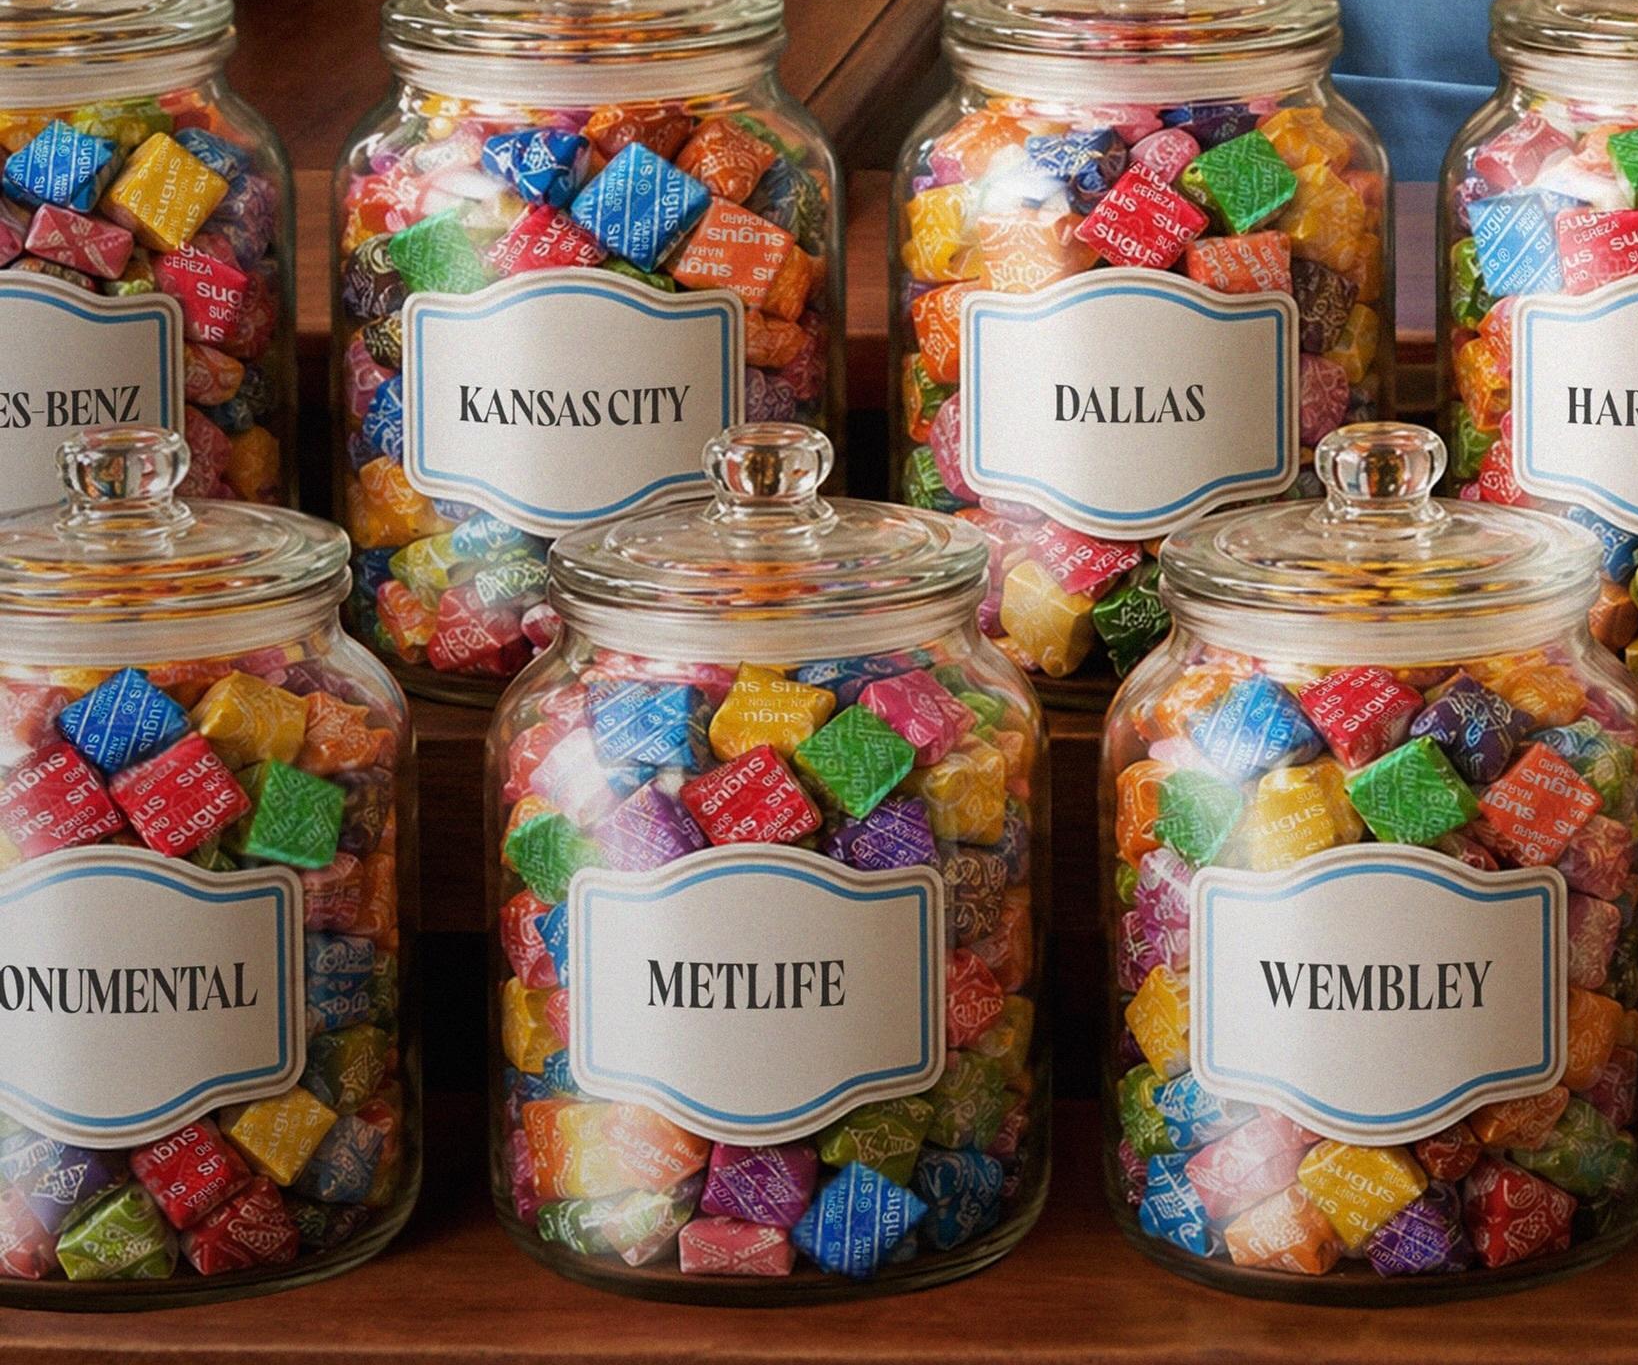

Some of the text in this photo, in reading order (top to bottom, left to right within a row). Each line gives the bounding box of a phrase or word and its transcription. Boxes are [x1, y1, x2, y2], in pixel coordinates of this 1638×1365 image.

[151, 156, 182, 228] sugus
[664, 166, 681, 232] sugus
[1131, 180, 1176, 214] CEREZA
[706, 226, 785, 248] sugus
[1092, 220, 1165, 267] sugus
[1477, 201, 1511, 247] sugus
[1572, 219, 1620, 246] CEREZA
[162, 255, 213, 276] CEREZA
[459, 386, 691, 427] KANSAS CITY
[1055, 384, 1206, 424] DALLAS
[140, 699, 164, 754] sugus
[1341, 684, 1400, 733] sugus
[701, 757, 765, 816] sugus
[1519, 765, 1597, 808] sugus
[166, 790, 239, 848] sugus
[647, 959, 846, 1010] METLIFE
[1259, 959, 1493, 1012] WEMBLEY
[1325, 1161, 1395, 1204] sugus
[882, 1187, 901, 1250] sugus
